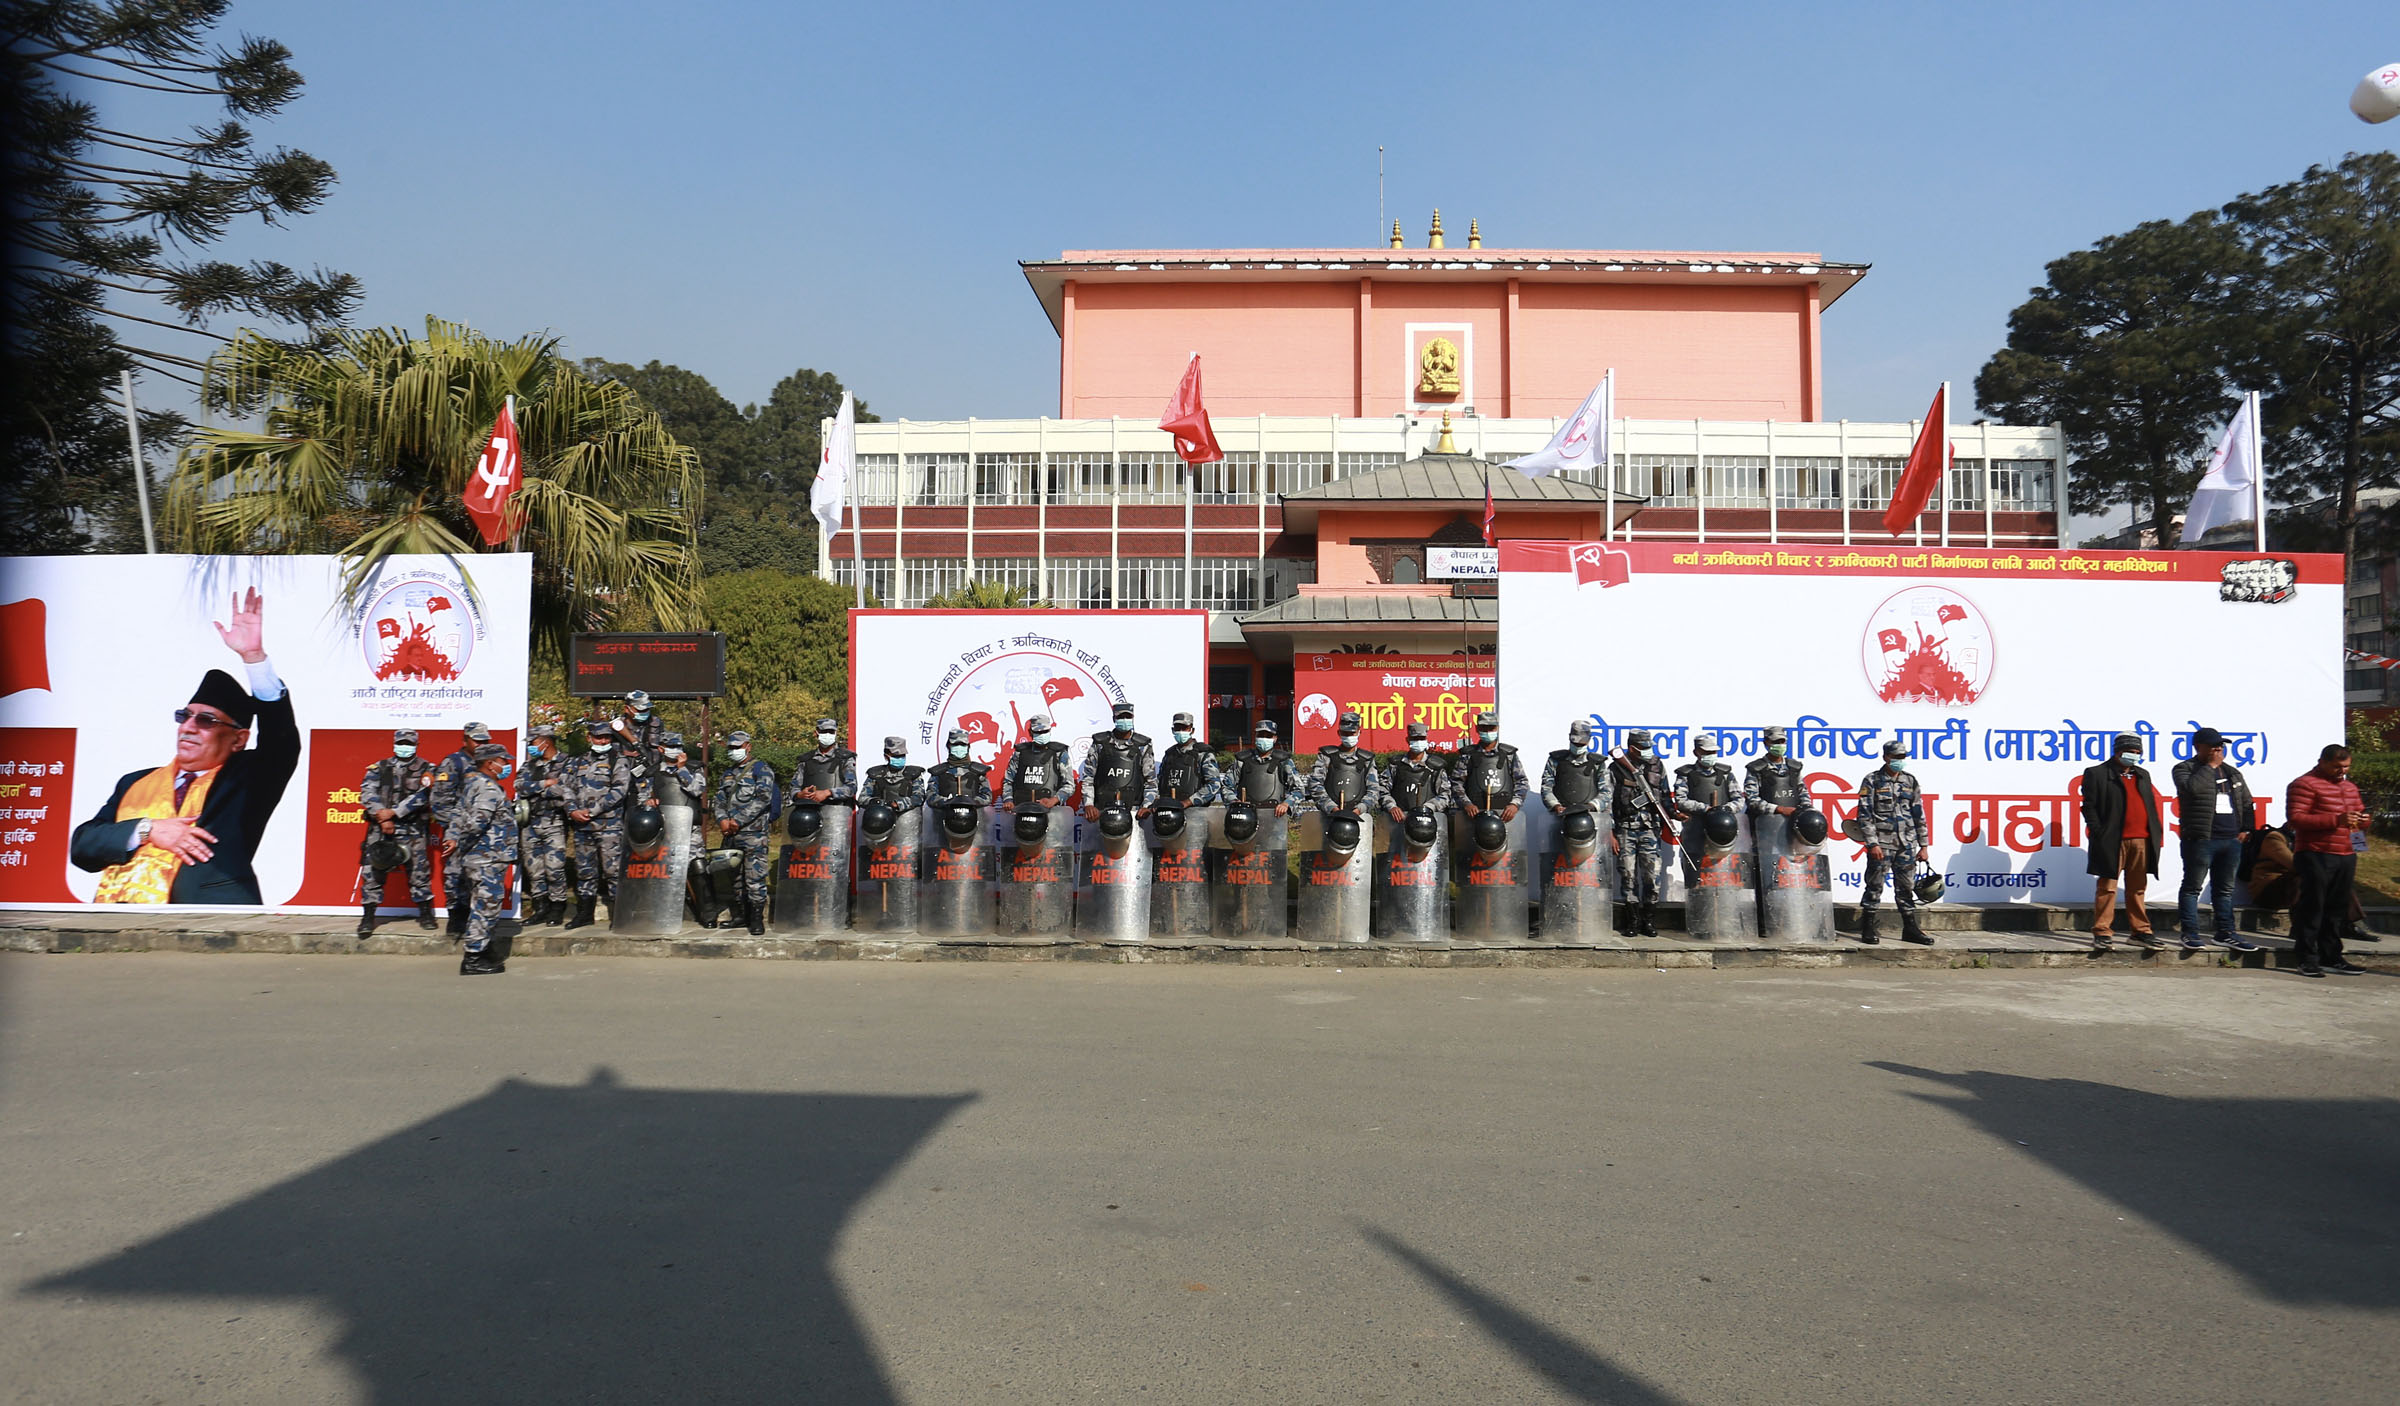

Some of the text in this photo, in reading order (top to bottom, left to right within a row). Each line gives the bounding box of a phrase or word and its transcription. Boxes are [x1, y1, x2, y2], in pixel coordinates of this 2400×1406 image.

[1450, 550, 1478, 559] नेपाल
[1451, 565, 1498, 574] NEPAL A
[1702, 551, 1773, 567] क्रान्तिकारी
[1776, 552, 1811, 567] विचार
[1815, 556, 1824, 567] र
[1827, 553, 1898, 568] क्रान्तिकारी
[1902, 554, 1928, 568] पार्टी
[1931, 554, 1988, 569] निर्माणका
[1991, 555, 2023, 570] लागि
[2059, 556, 2100, 574] राष्ट्रिय
[2103, 557, 2169, 573] महाधिवेशन
[1436, 660, 1474, 669] क्रान्तिकरी
[926, 663, 964, 716] क्रान्तिकारी
[961, 643, 993, 668] विचार
[999, 639, 1006, 650] र
[1012, 631, 1073, 655] क्रान्तिकारी
[1076, 649, 1100, 670] पार्टी
[1382, 673, 1416, 688] नेपाल
[1419, 673, 1476, 691] कम्युनिष्ट
[419, 686, 484, 699] महाधिवेशन
[48, 761, 65, 775] को
[1107, 767, 1131, 778] APF
[1023, 775, 1044, 785] NEPAL
[29, 786, 43, 797] मा
[14, 806, 49, 825] सम्पूर्ण
[4, 828, 38, 845] हार्दिक
[627, 864, 670, 879] NEPAL
[788, 864, 833, 879] NEPAL
[870, 864, 916, 879] NEPAL
[936, 865, 983, 880] NEPAL
[1013, 867, 1059, 882] NEPAL
[1159, 867, 1205, 882] NEPAL
[1227, 870, 1273, 885] NEPAL
[1311, 871, 1357, 886] NEPAL
[1390, 871, 1436, 886] NEPAL
[1470, 870, 1516, 885] NEPAL
[1554, 871, 1600, 887] NEPAL
[1700, 872, 1744, 887] NEPAL
[1777, 873, 1823, 888] NEPAL
